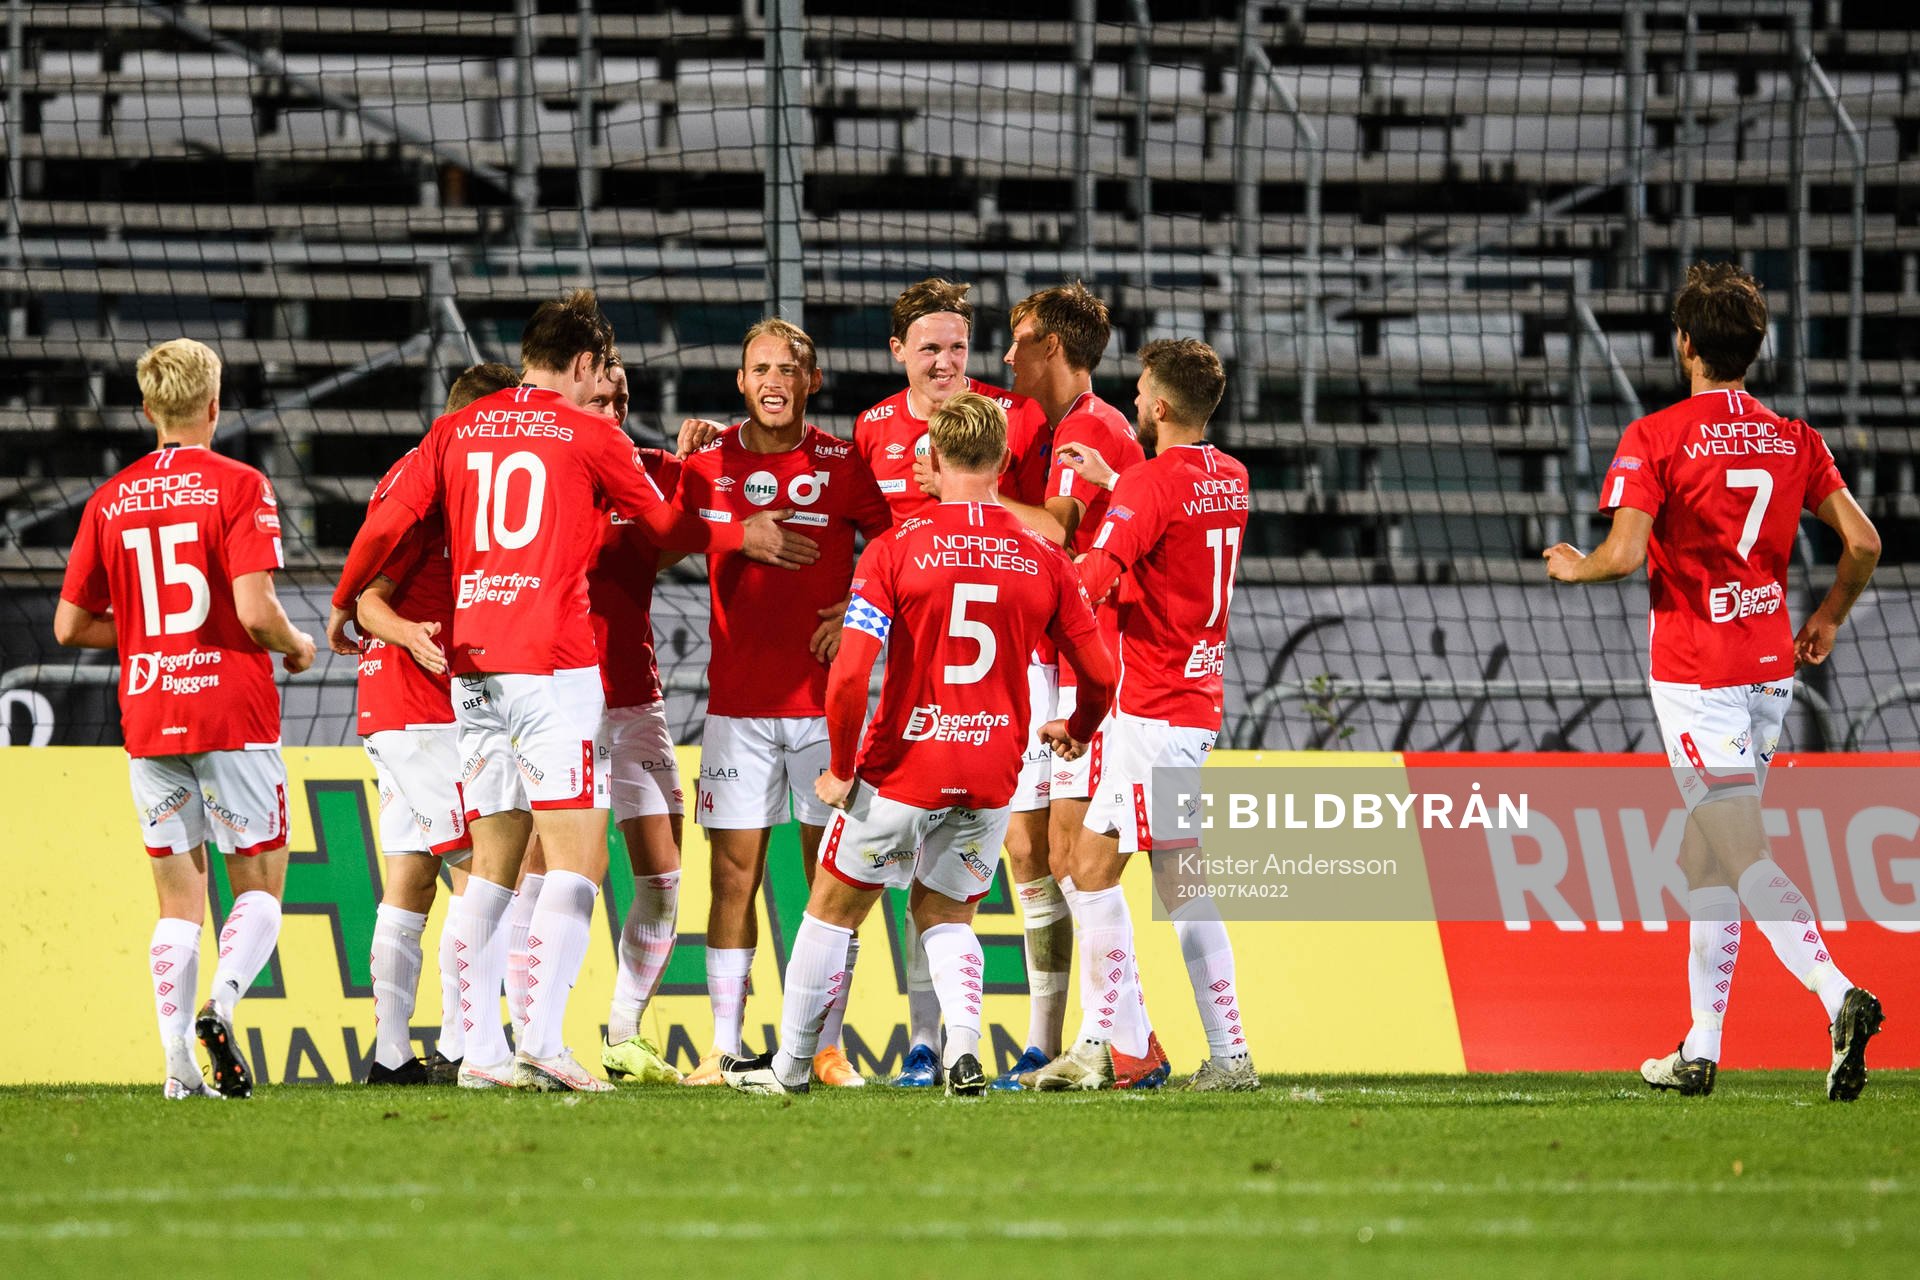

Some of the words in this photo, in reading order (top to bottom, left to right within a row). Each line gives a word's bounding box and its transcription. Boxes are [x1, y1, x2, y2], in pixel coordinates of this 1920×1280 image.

[475, 410, 556, 424] NORDIC
[864, 405, 895, 422] AVIS
[456, 424, 574, 442] WELLNESS
[1700, 422, 1778, 439] NORDIC
[1683, 438, 1797, 460] WELLNESS
[118, 472, 202, 497] NORDIC
[744, 484, 777, 495] MHE
[1193, 479, 1244, 497] NORDIC
[101, 489, 219, 521] WELLNESS
[467, 451, 547, 552] 10
[1726, 468, 1774, 561] 7
[908, 518, 934, 532] INFRA
[933, 535, 1019, 553] NORDIC
[914, 551, 1039, 576] WELLNESS
[121, 522, 211, 637] 15
[1205, 526, 1241, 628] 11
[944, 582, 998, 684] 5
[1760, 655, 1778, 663] umbro
[161, 674, 220, 695] Byggen
[162, 726, 188, 736] umbro
[934, 726, 991, 746] Energi
[941, 787, 968, 795] umbro
[202, 793, 249, 827] Toroma
[450, 809, 460, 834] umbro
